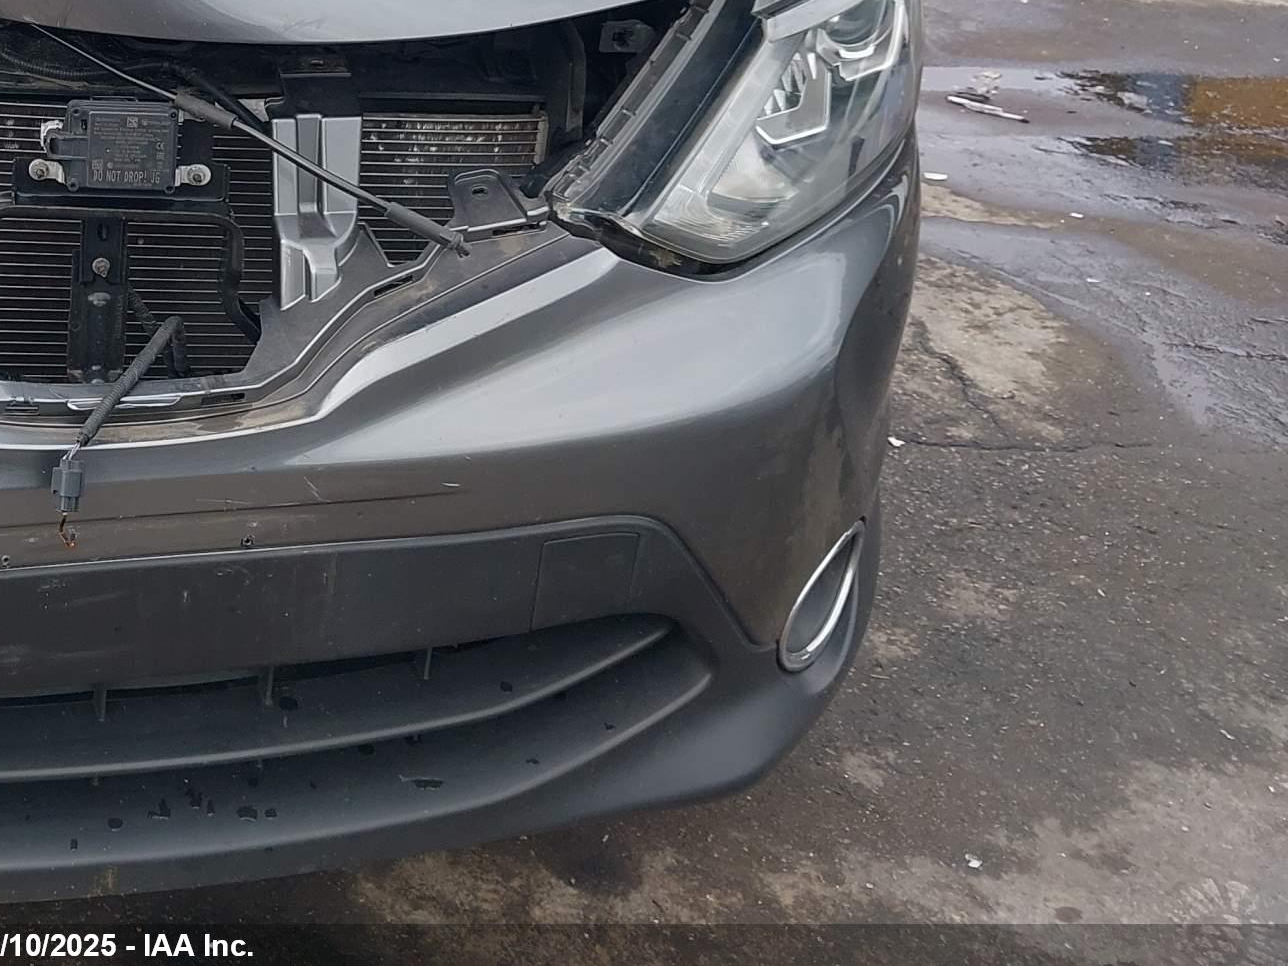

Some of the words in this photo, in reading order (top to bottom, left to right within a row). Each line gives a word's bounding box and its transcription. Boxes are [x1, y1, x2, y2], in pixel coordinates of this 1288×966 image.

[93, 169, 103, 181] DO
[105, 170, 121, 182] NOT
[124, 170, 147, 183] DROP!
